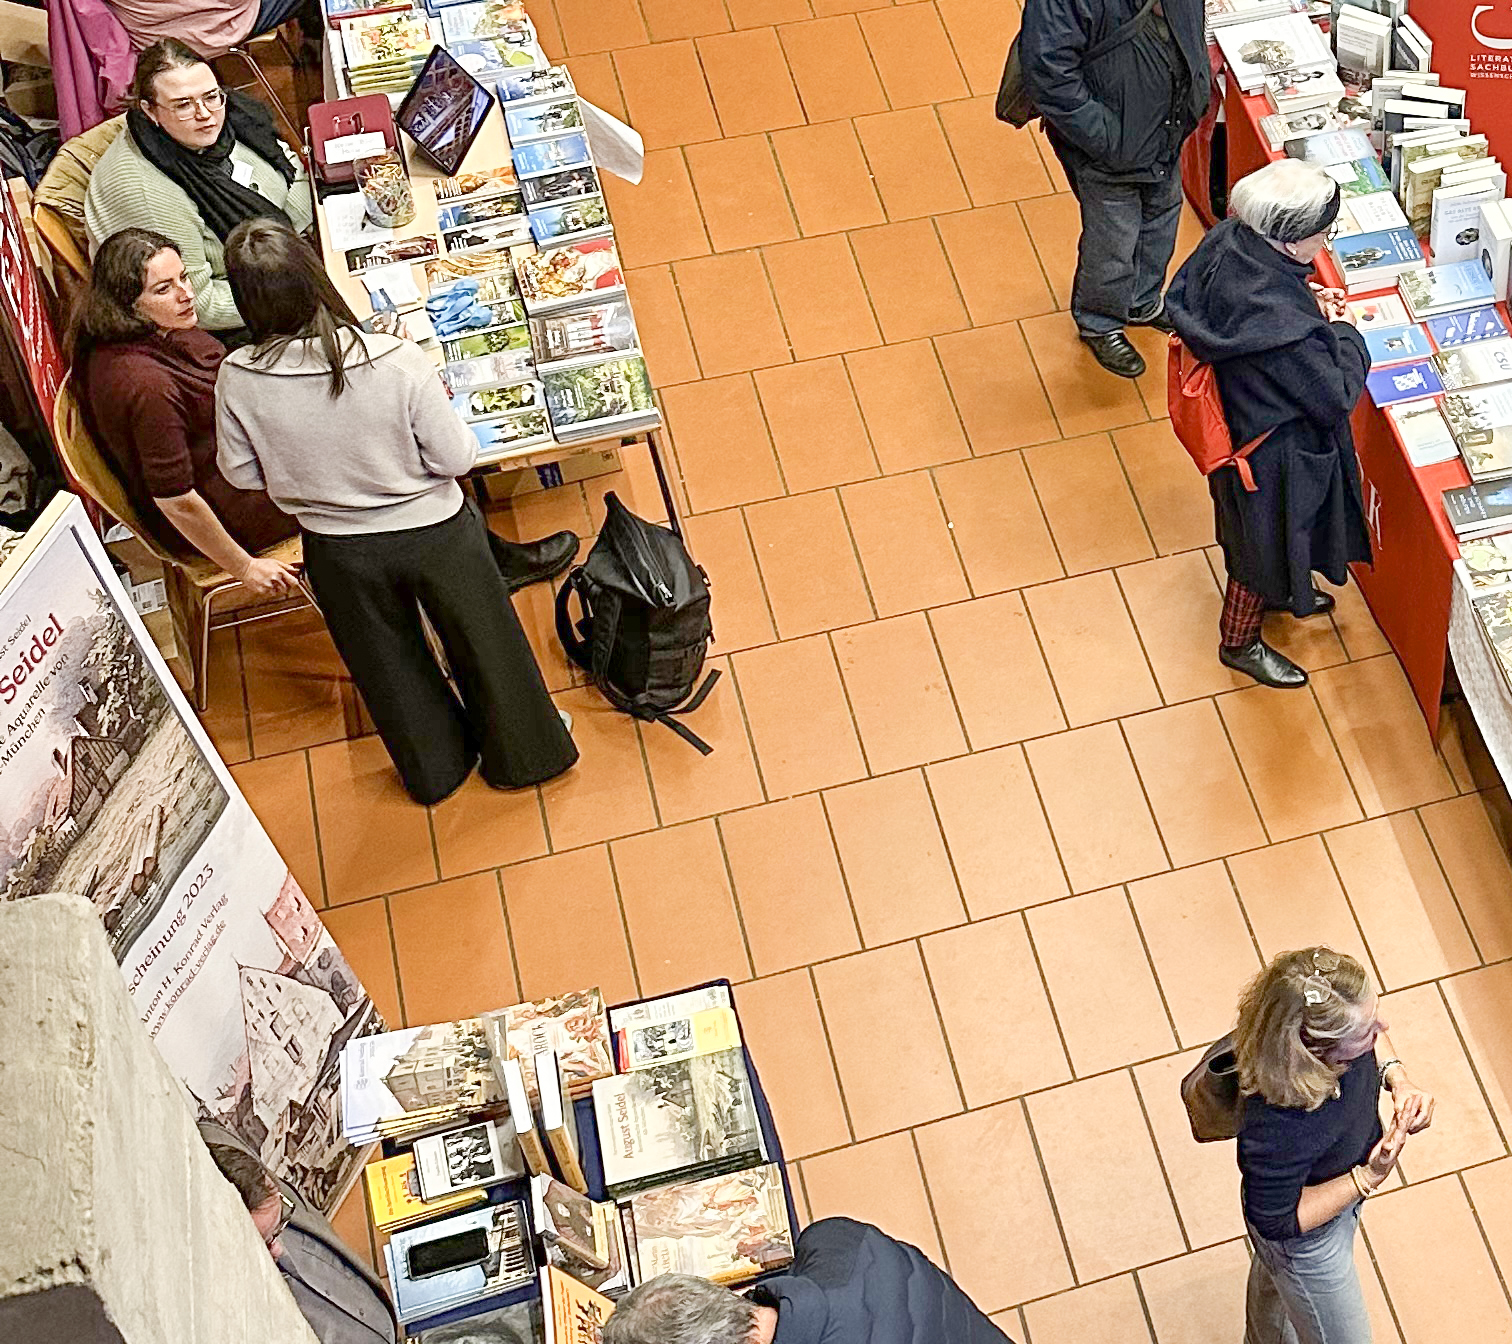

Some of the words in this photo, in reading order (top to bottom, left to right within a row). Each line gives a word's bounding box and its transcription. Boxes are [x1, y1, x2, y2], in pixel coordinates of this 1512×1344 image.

[0, 613, 66, 705] Seidel
[6, 675, 50, 736] Aquarelle
[48, 652, 70, 680] von
[182, 862, 214, 911] 2023
[161, 974, 176, 991] H.
[172, 928, 204, 977] Konrad
[200, 893, 230, 931] Verlag
[531, 1021, 548, 1056] AROCK
[616, 1092, 629, 1125] Seidel
[622, 1125, 636, 1160] August
